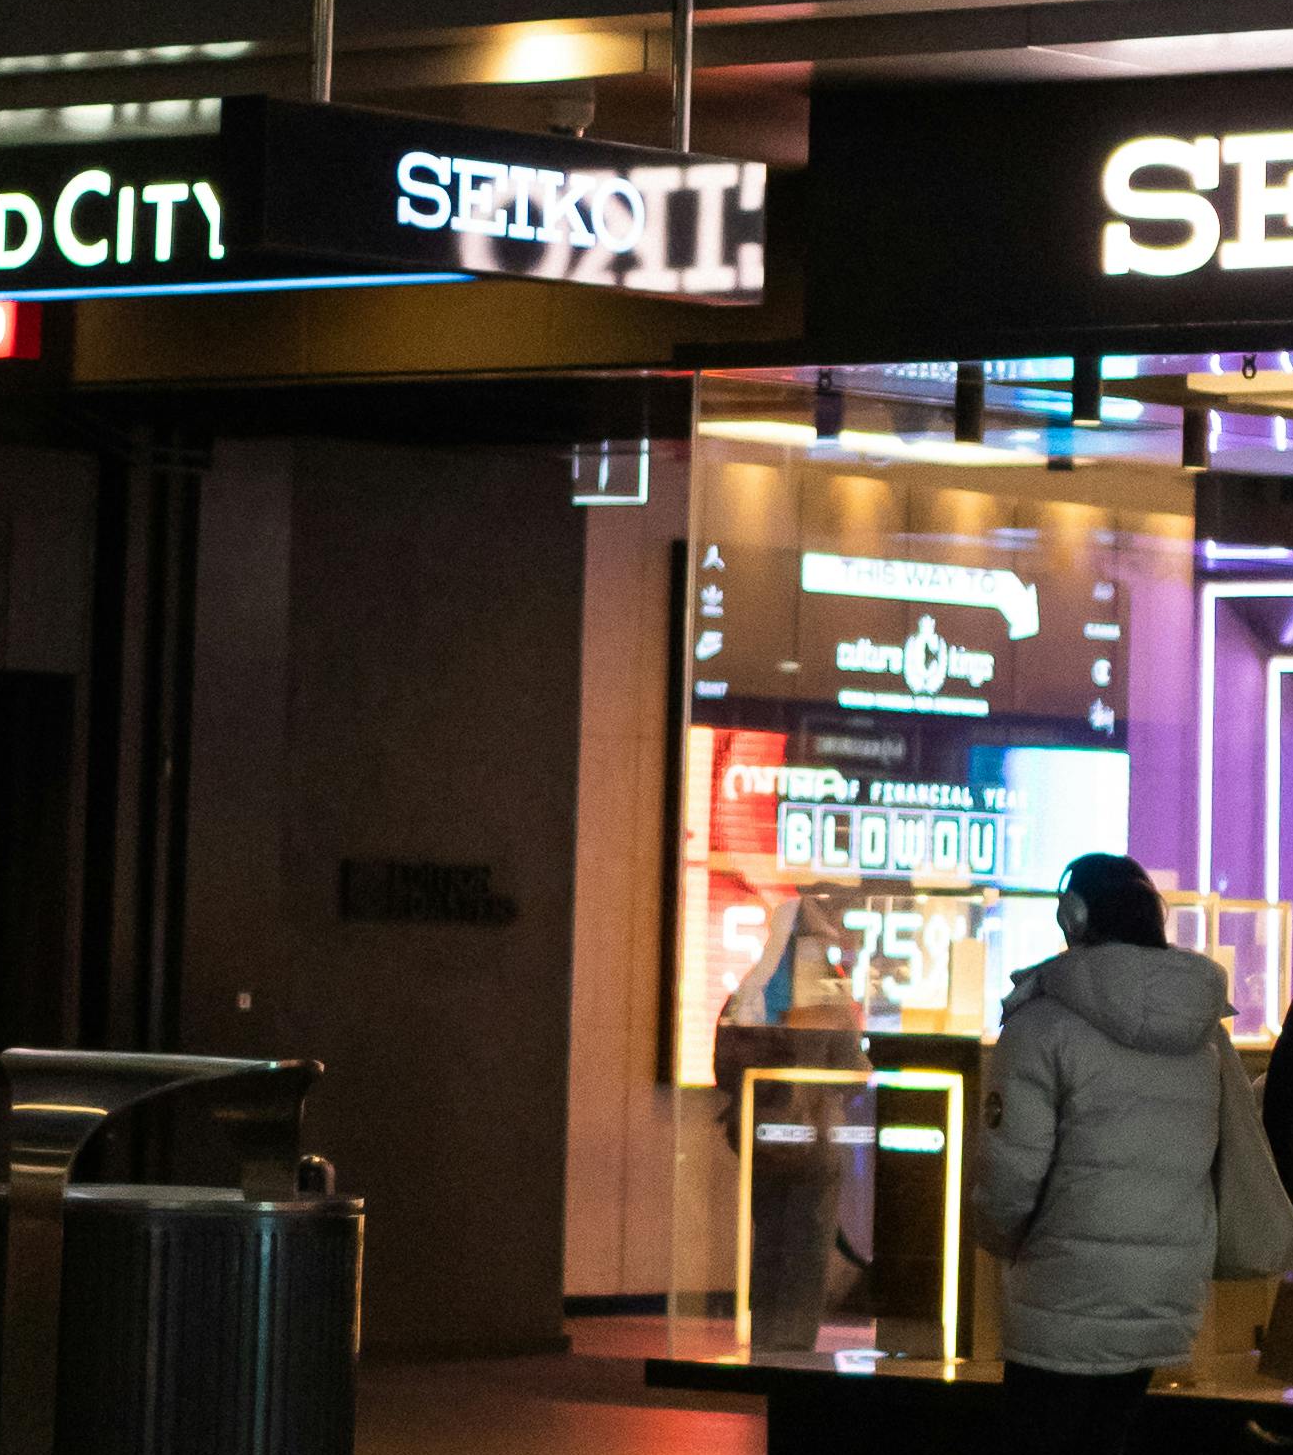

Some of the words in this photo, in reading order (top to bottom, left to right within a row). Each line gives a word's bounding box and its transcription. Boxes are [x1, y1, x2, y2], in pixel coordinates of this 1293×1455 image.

[396, 150, 646, 255] SEIKO
[840, 557, 898, 586] THIS
[904, 561, 957, 588] WAY
[965, 569, 998, 594] TO
[869, 779, 974, 811] FINANCIAL
[784, 811, 1027, 872] BLOWOUT
